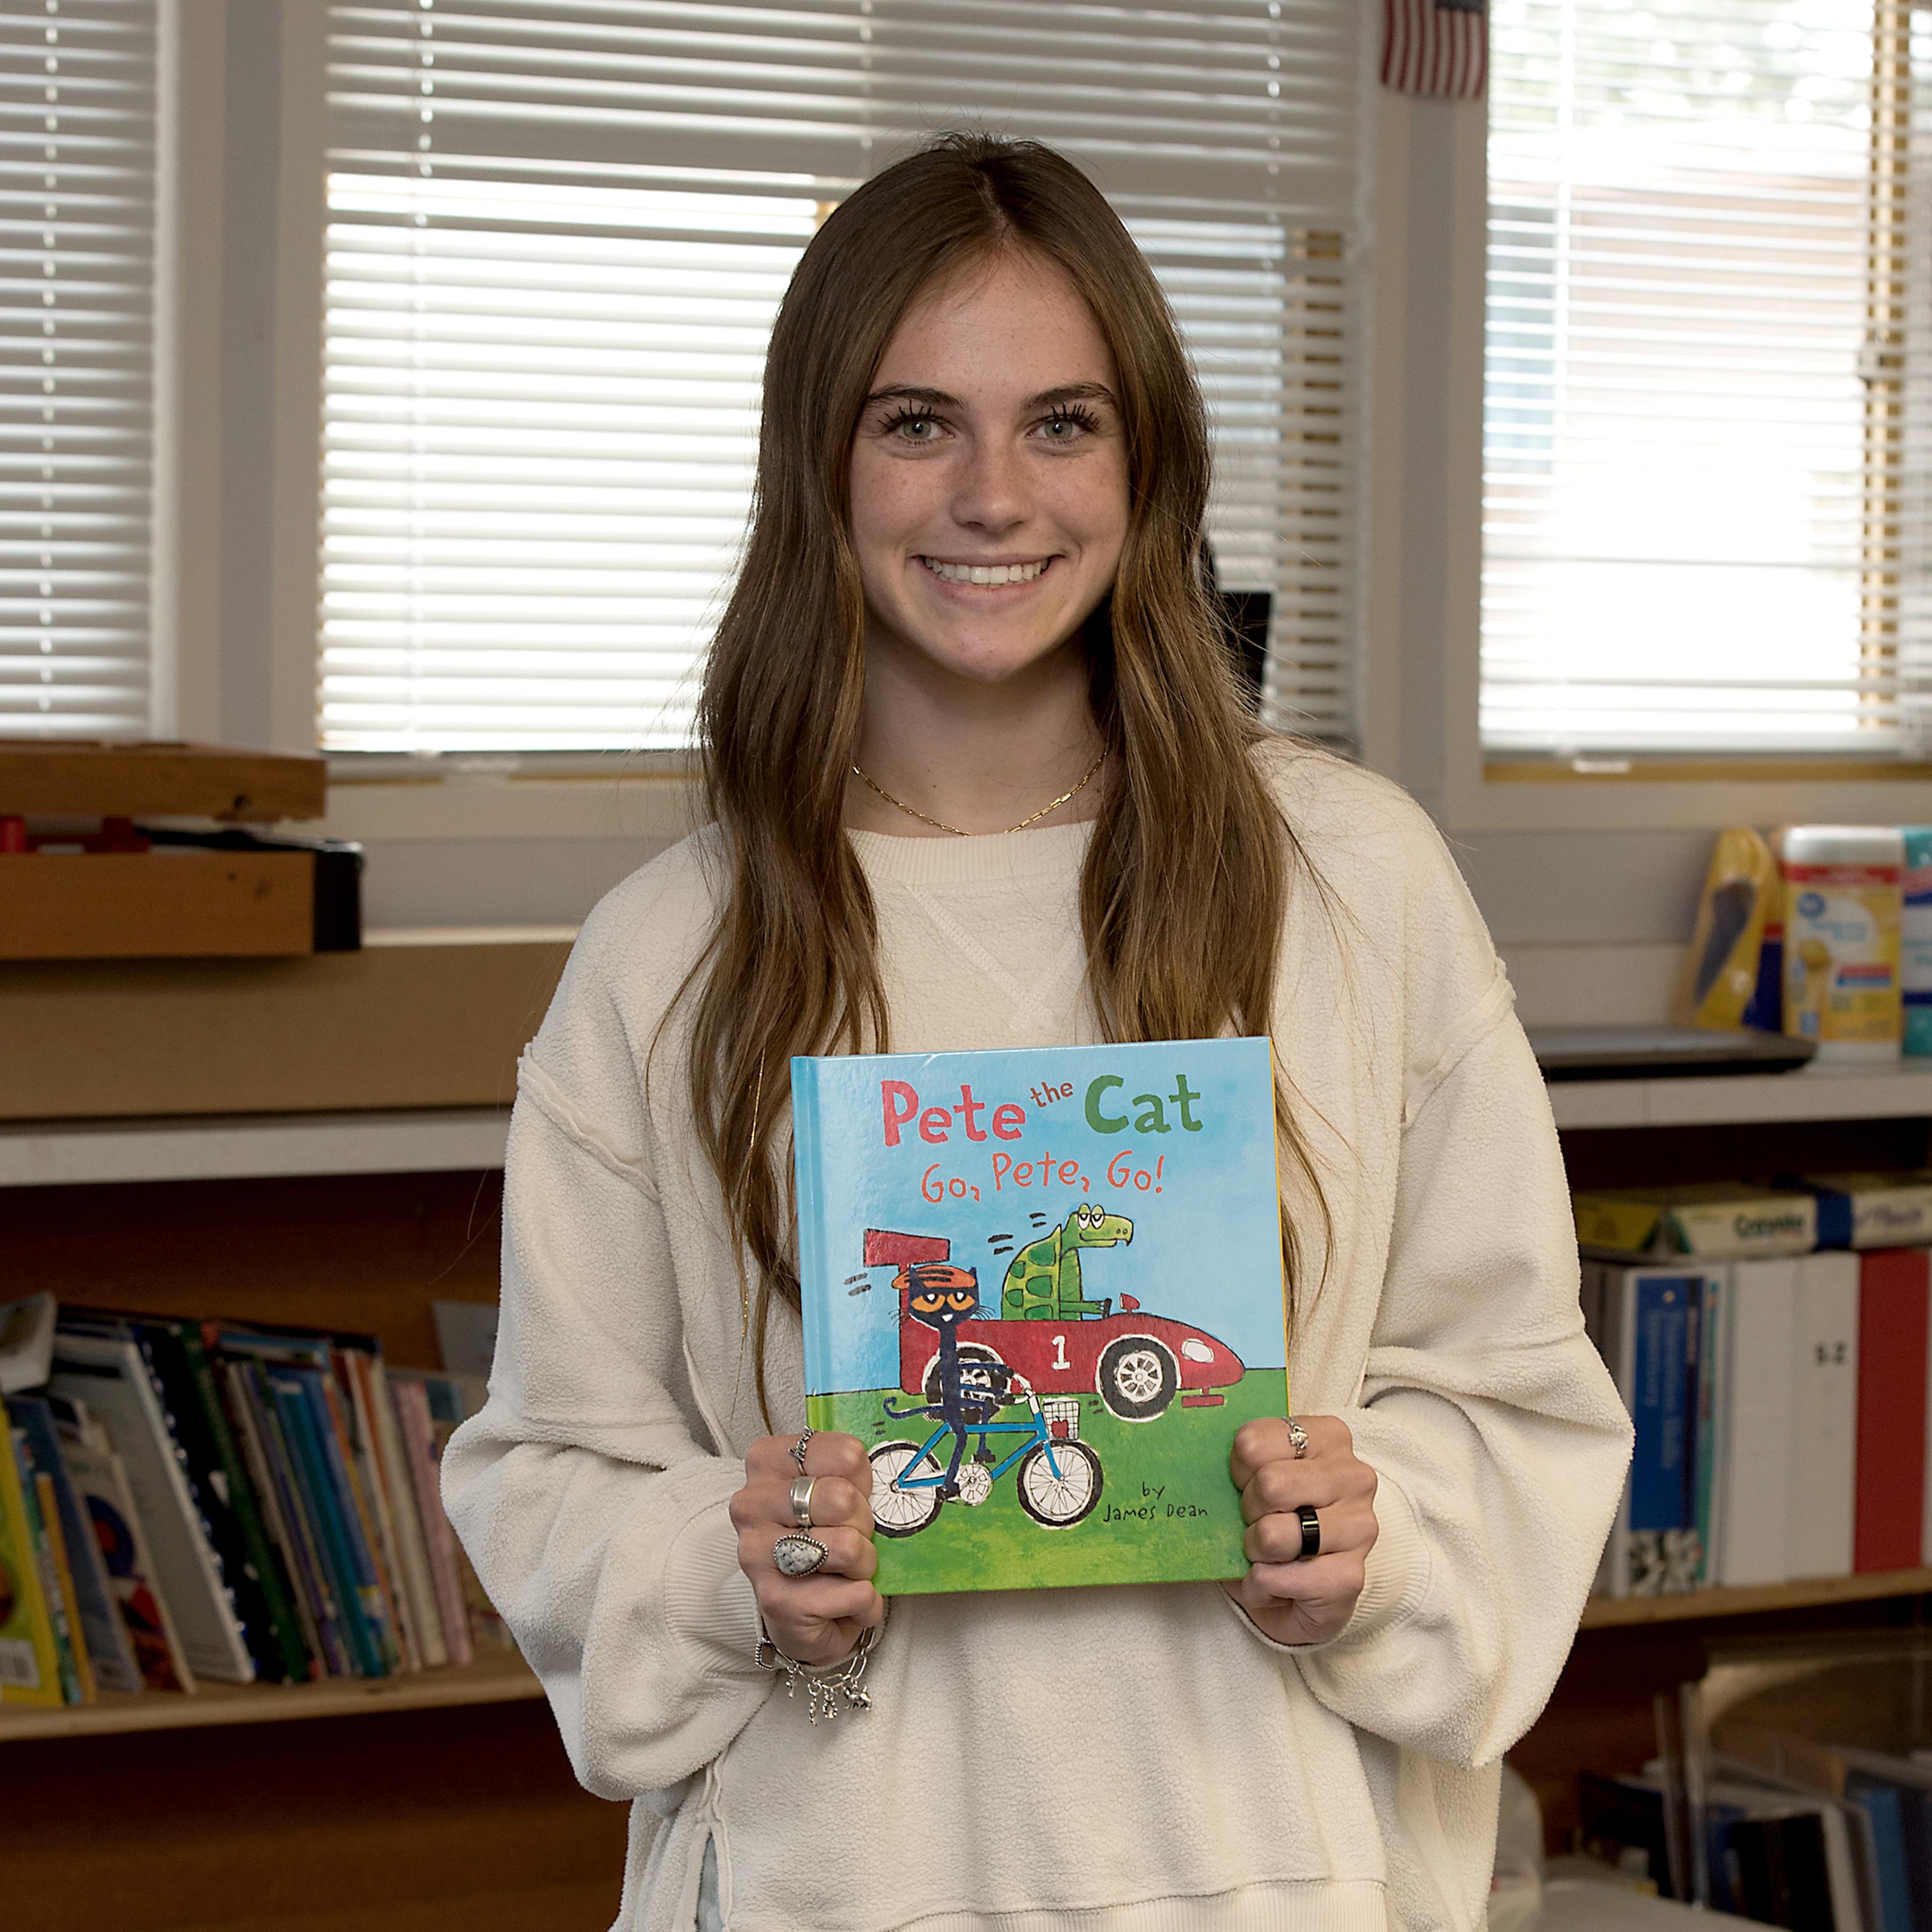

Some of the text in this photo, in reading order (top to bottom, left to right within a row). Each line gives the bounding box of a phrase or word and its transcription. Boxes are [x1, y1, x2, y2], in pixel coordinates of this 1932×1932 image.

[881, 1074, 1204, 1147] Pete the Cat
[921, 1150, 1165, 1203] Go, Pete, Go!
[1051, 1335, 1071, 1370] 1
[1142, 1481, 1166, 1500] by
[1102, 1503, 1208, 1523] James Dean
